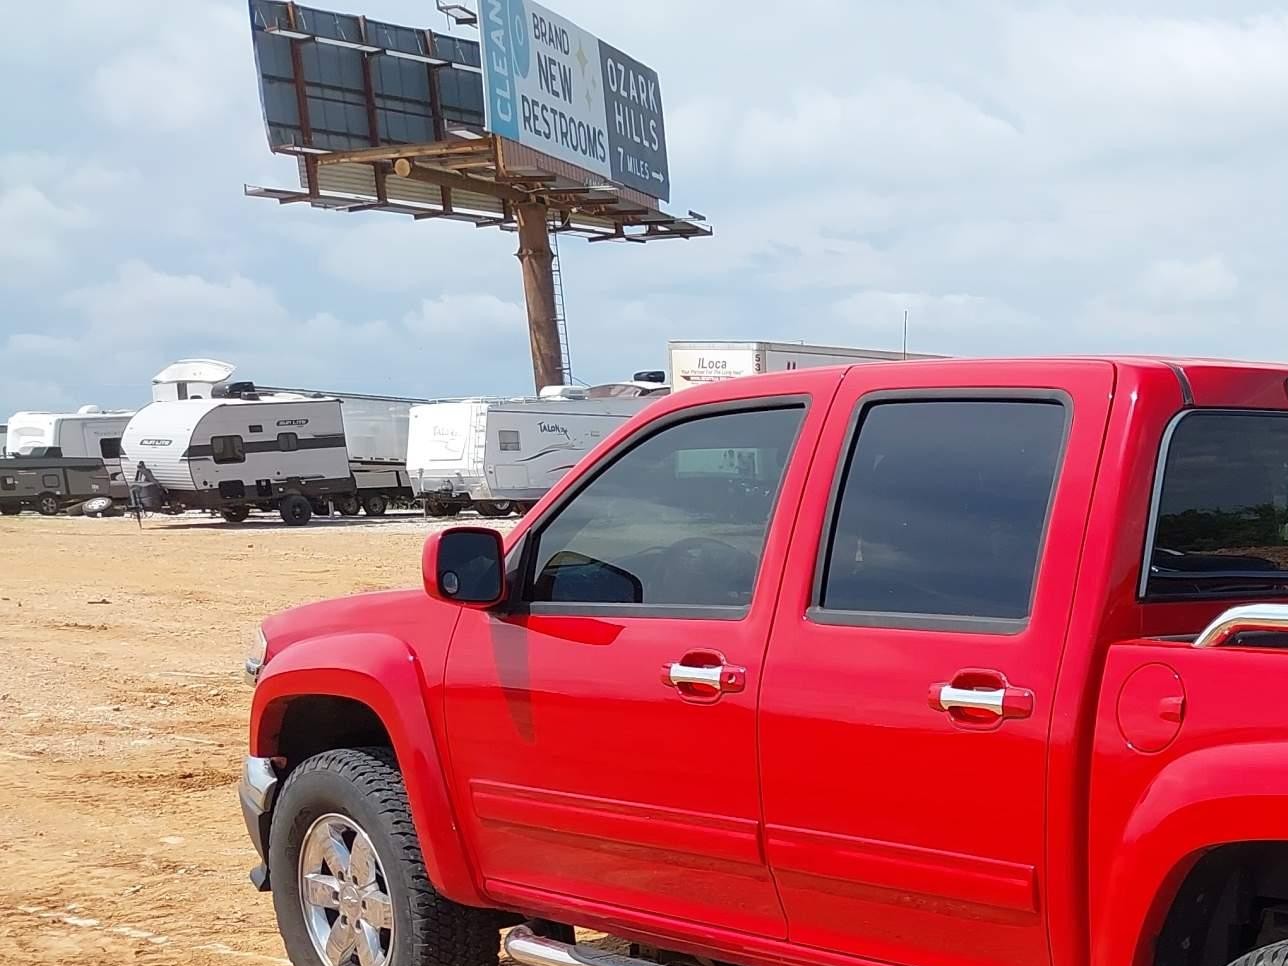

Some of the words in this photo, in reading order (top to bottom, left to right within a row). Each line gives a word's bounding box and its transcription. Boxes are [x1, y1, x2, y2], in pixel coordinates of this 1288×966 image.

[532, 12, 570, 56] BRAND
[488, 0, 512, 122] CLEAN
[537, 51, 573, 104] NEW
[607, 57, 658, 114] OZARK
[521, 94, 606, 163] RESTROOMS
[614, 100, 659, 152] HILLS
[617, 146, 625, 173] 7
[627, 158, 650, 181] MILES
[537, 421, 561, 433] TALON
